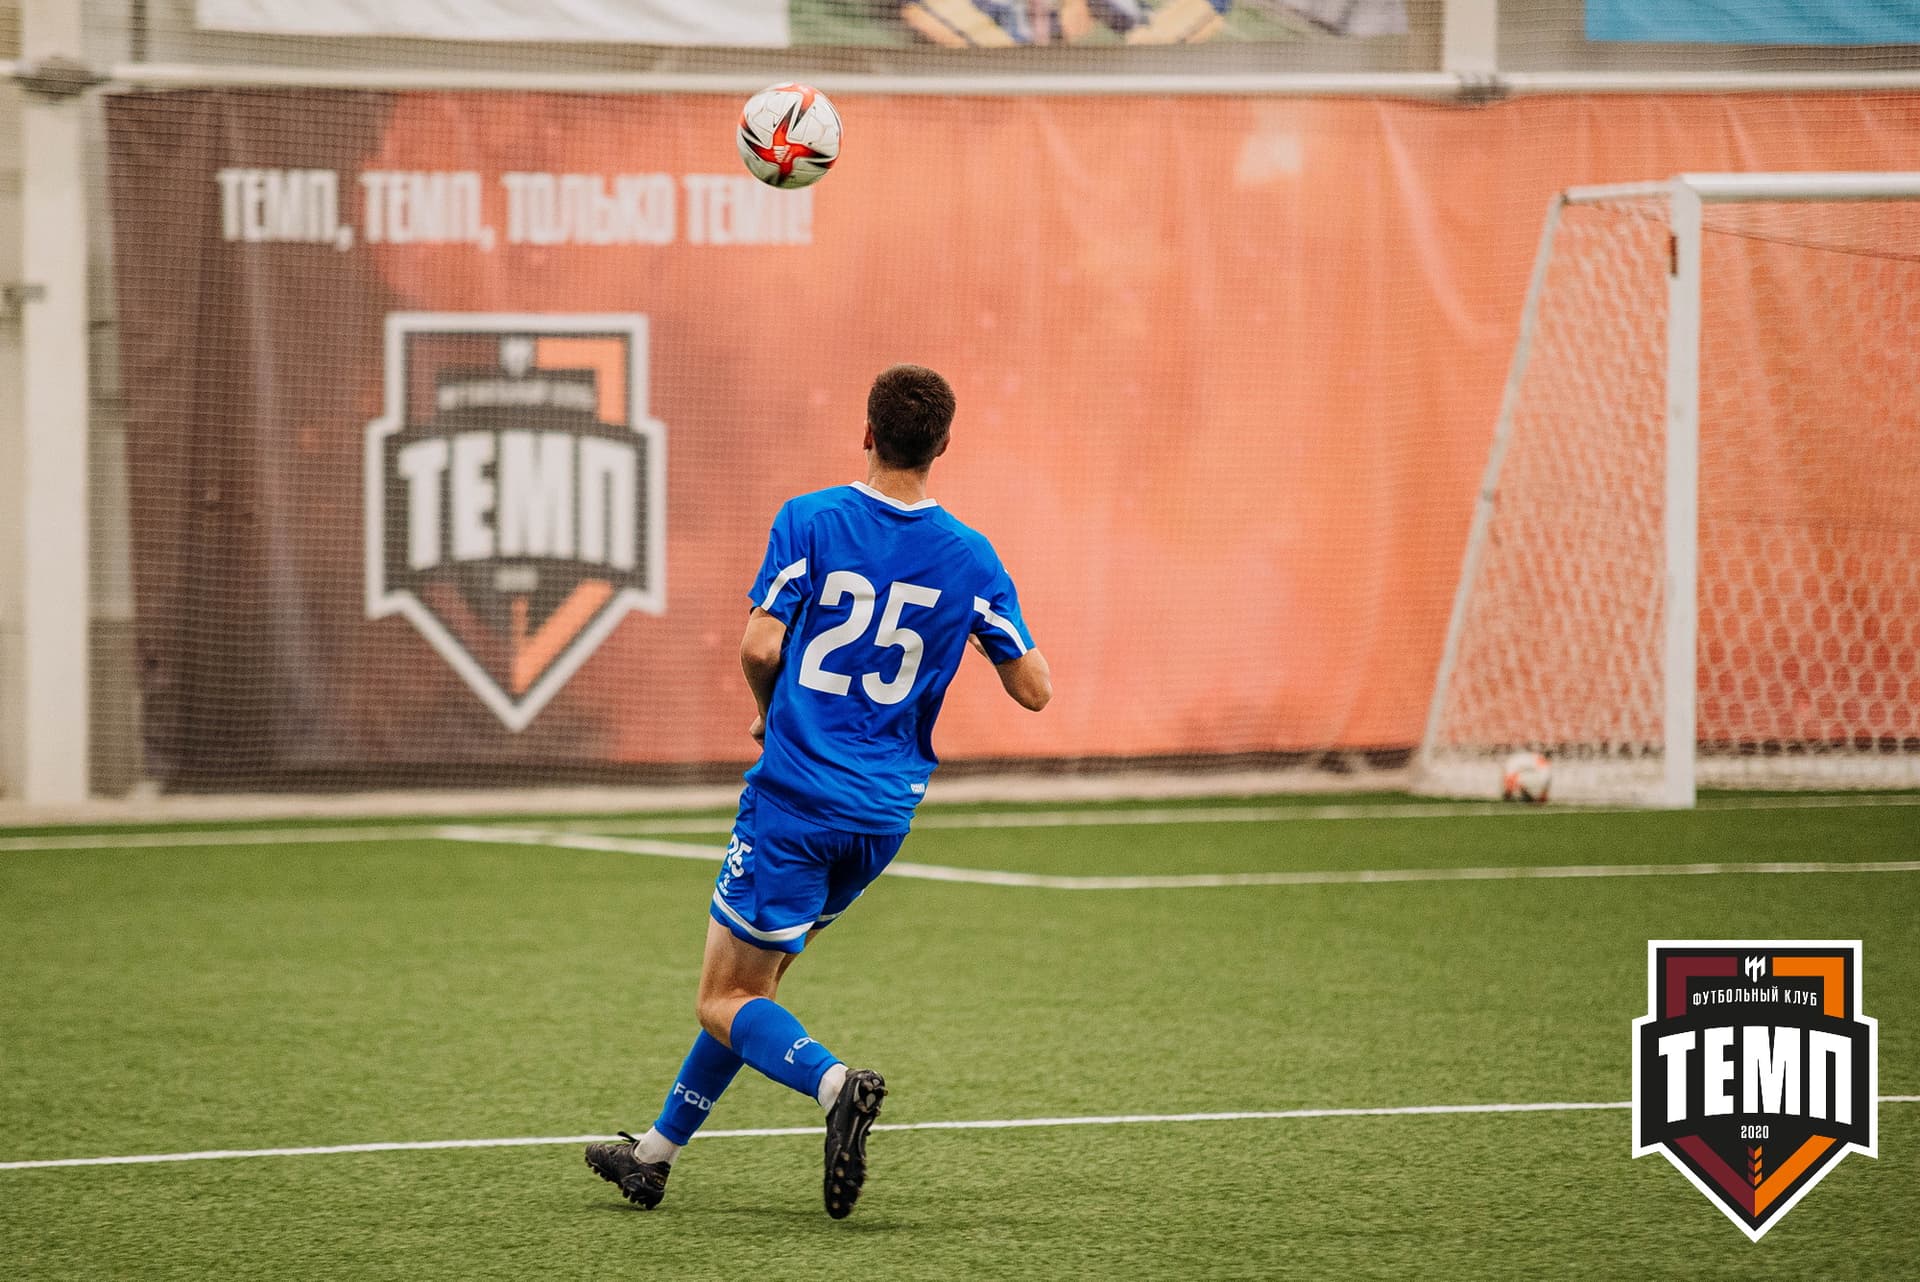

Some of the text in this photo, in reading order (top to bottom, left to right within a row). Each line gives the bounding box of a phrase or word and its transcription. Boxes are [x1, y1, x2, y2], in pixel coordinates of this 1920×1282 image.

[219, 169, 352, 251] ТЕМП,
[503, 173, 675, 245] ТОЛЬКО
[397, 430, 636, 573] ТЕМП
[799, 571, 942, 705] 25
